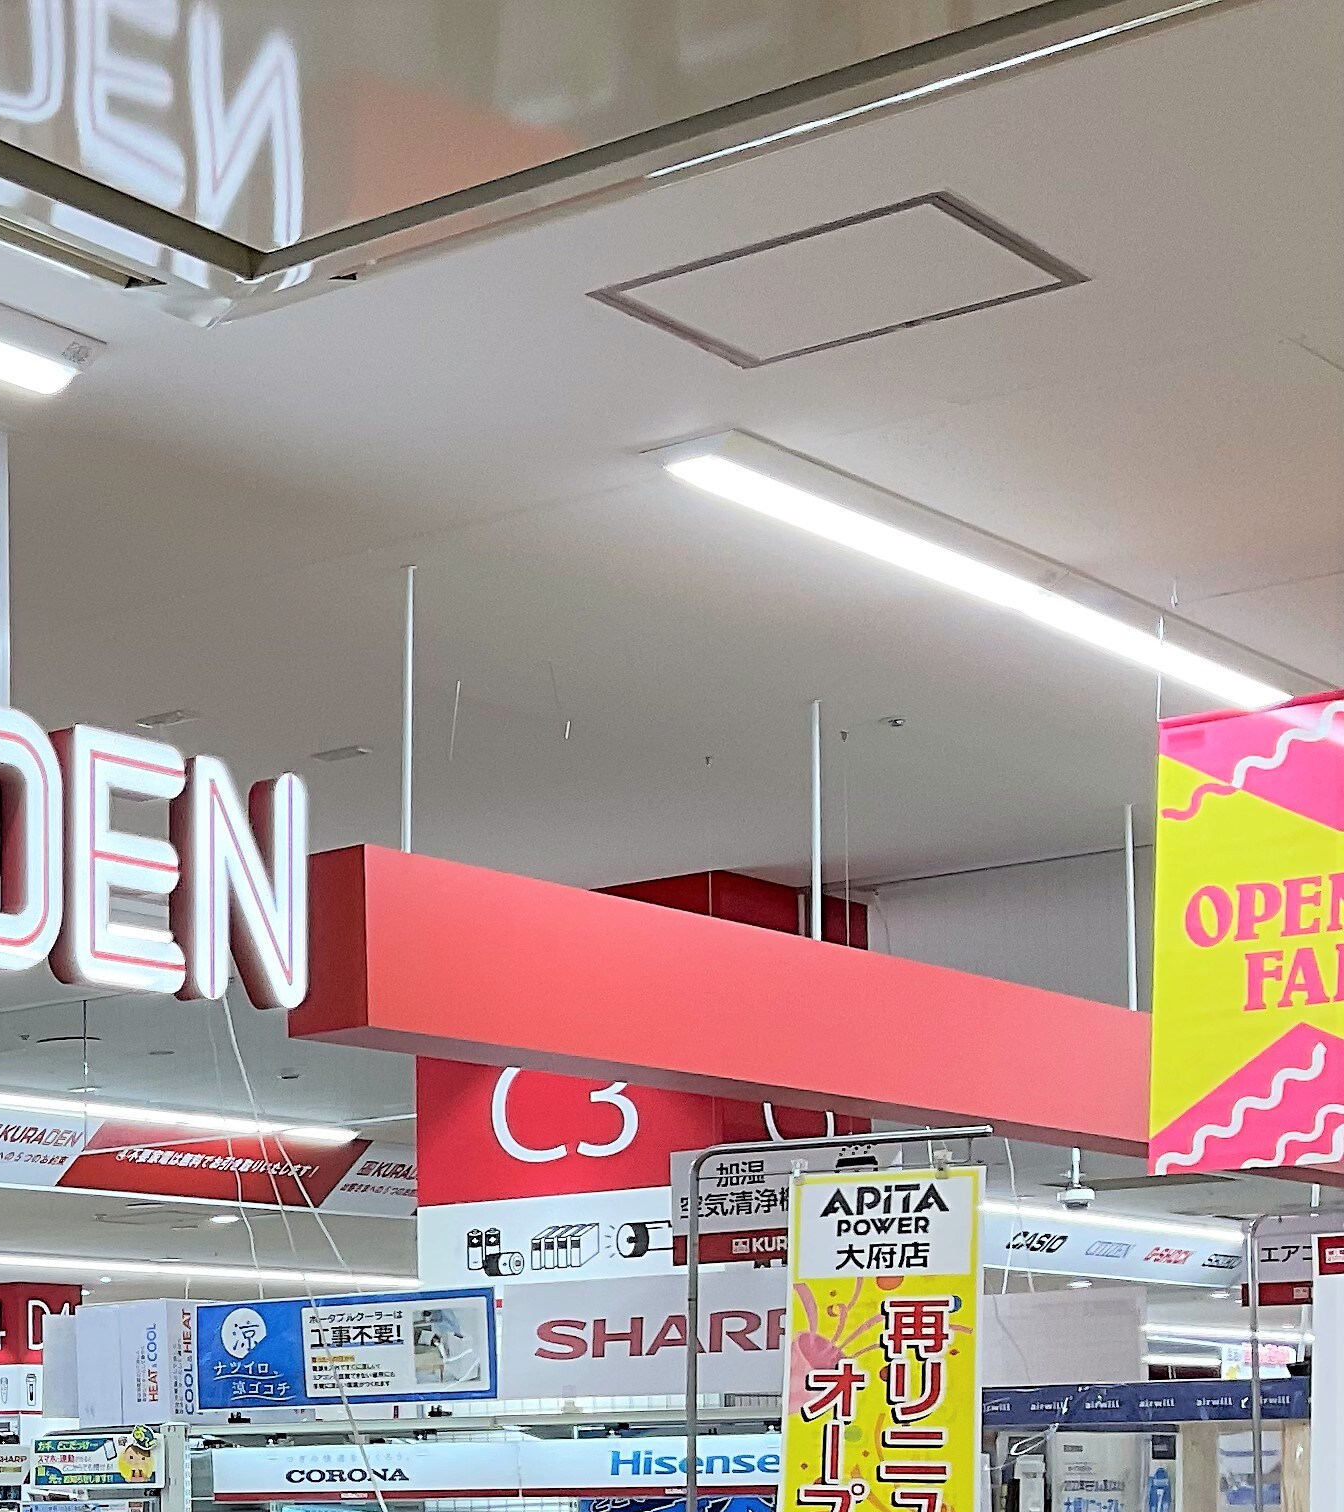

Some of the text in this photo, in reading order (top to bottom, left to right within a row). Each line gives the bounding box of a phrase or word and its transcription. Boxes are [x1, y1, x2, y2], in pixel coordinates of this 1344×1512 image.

[491, 1067, 640, 1163] C3
[715, 1160, 765, 1188] 加湿
[836, 1216, 930, 1237] POWER
[836, 1242, 930, 1271] 大府店
[285, 1467, 409, 1483] CORONA
